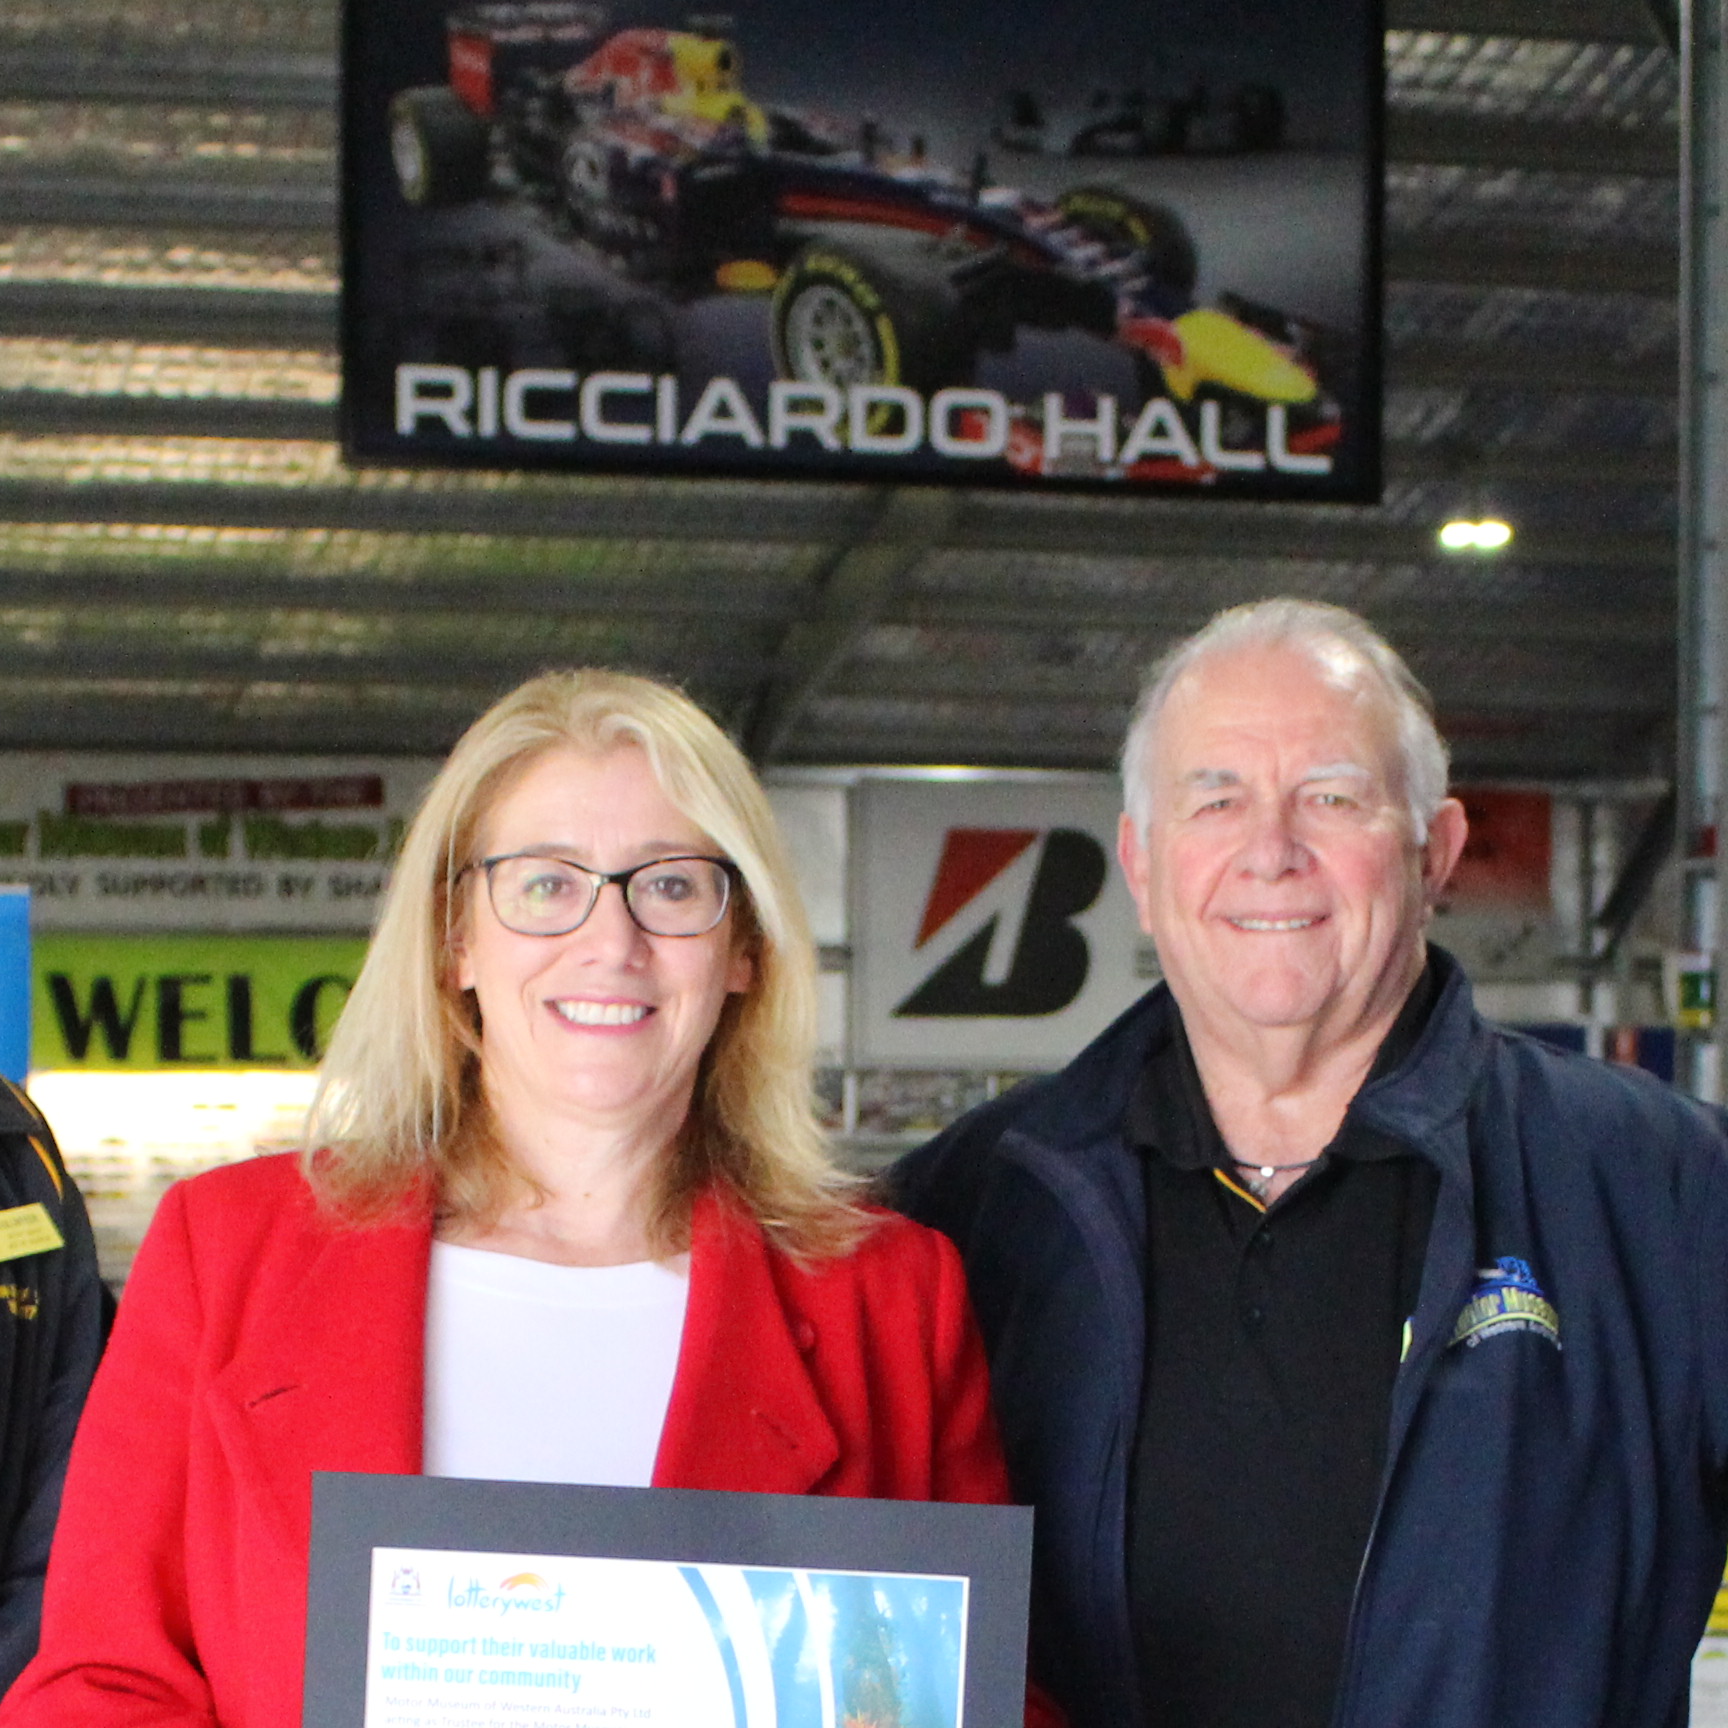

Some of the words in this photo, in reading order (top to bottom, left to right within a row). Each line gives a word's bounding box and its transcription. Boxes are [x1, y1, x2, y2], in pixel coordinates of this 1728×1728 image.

[394, 363, 1010, 459] RICCIARDO
[1043, 392, 1333, 474] HALL
[95, 871, 265, 899] SUPPORTED
[276, 871, 315, 900] BY
[45, 970, 356, 1063] WELC
[447, 1574, 567, 1616] lotterywest
[383, 1631, 401, 1652] To
[406, 1634, 478, 1659] support
[481, 1636, 525, 1659] their
[530, 1639, 607, 1663] valuable
[611, 1643, 657, 1664] work
[381, 1660, 439, 1683] within
[443, 1668, 473, 1684] our
[478, 1665, 582, 1694] community
[384, 1714, 421, 1728] acting
[385, 1696, 423, 1709] Motor
[427, 1698, 481, 1712] Museum
[484, 1699, 498, 1712] of
[500, 1701, 551, 1715] Western
[553, 1703, 607, 1717] Australia
[611, 1704, 630, 1720] Pty
[633, 1706, 652, 1720] Ltd
